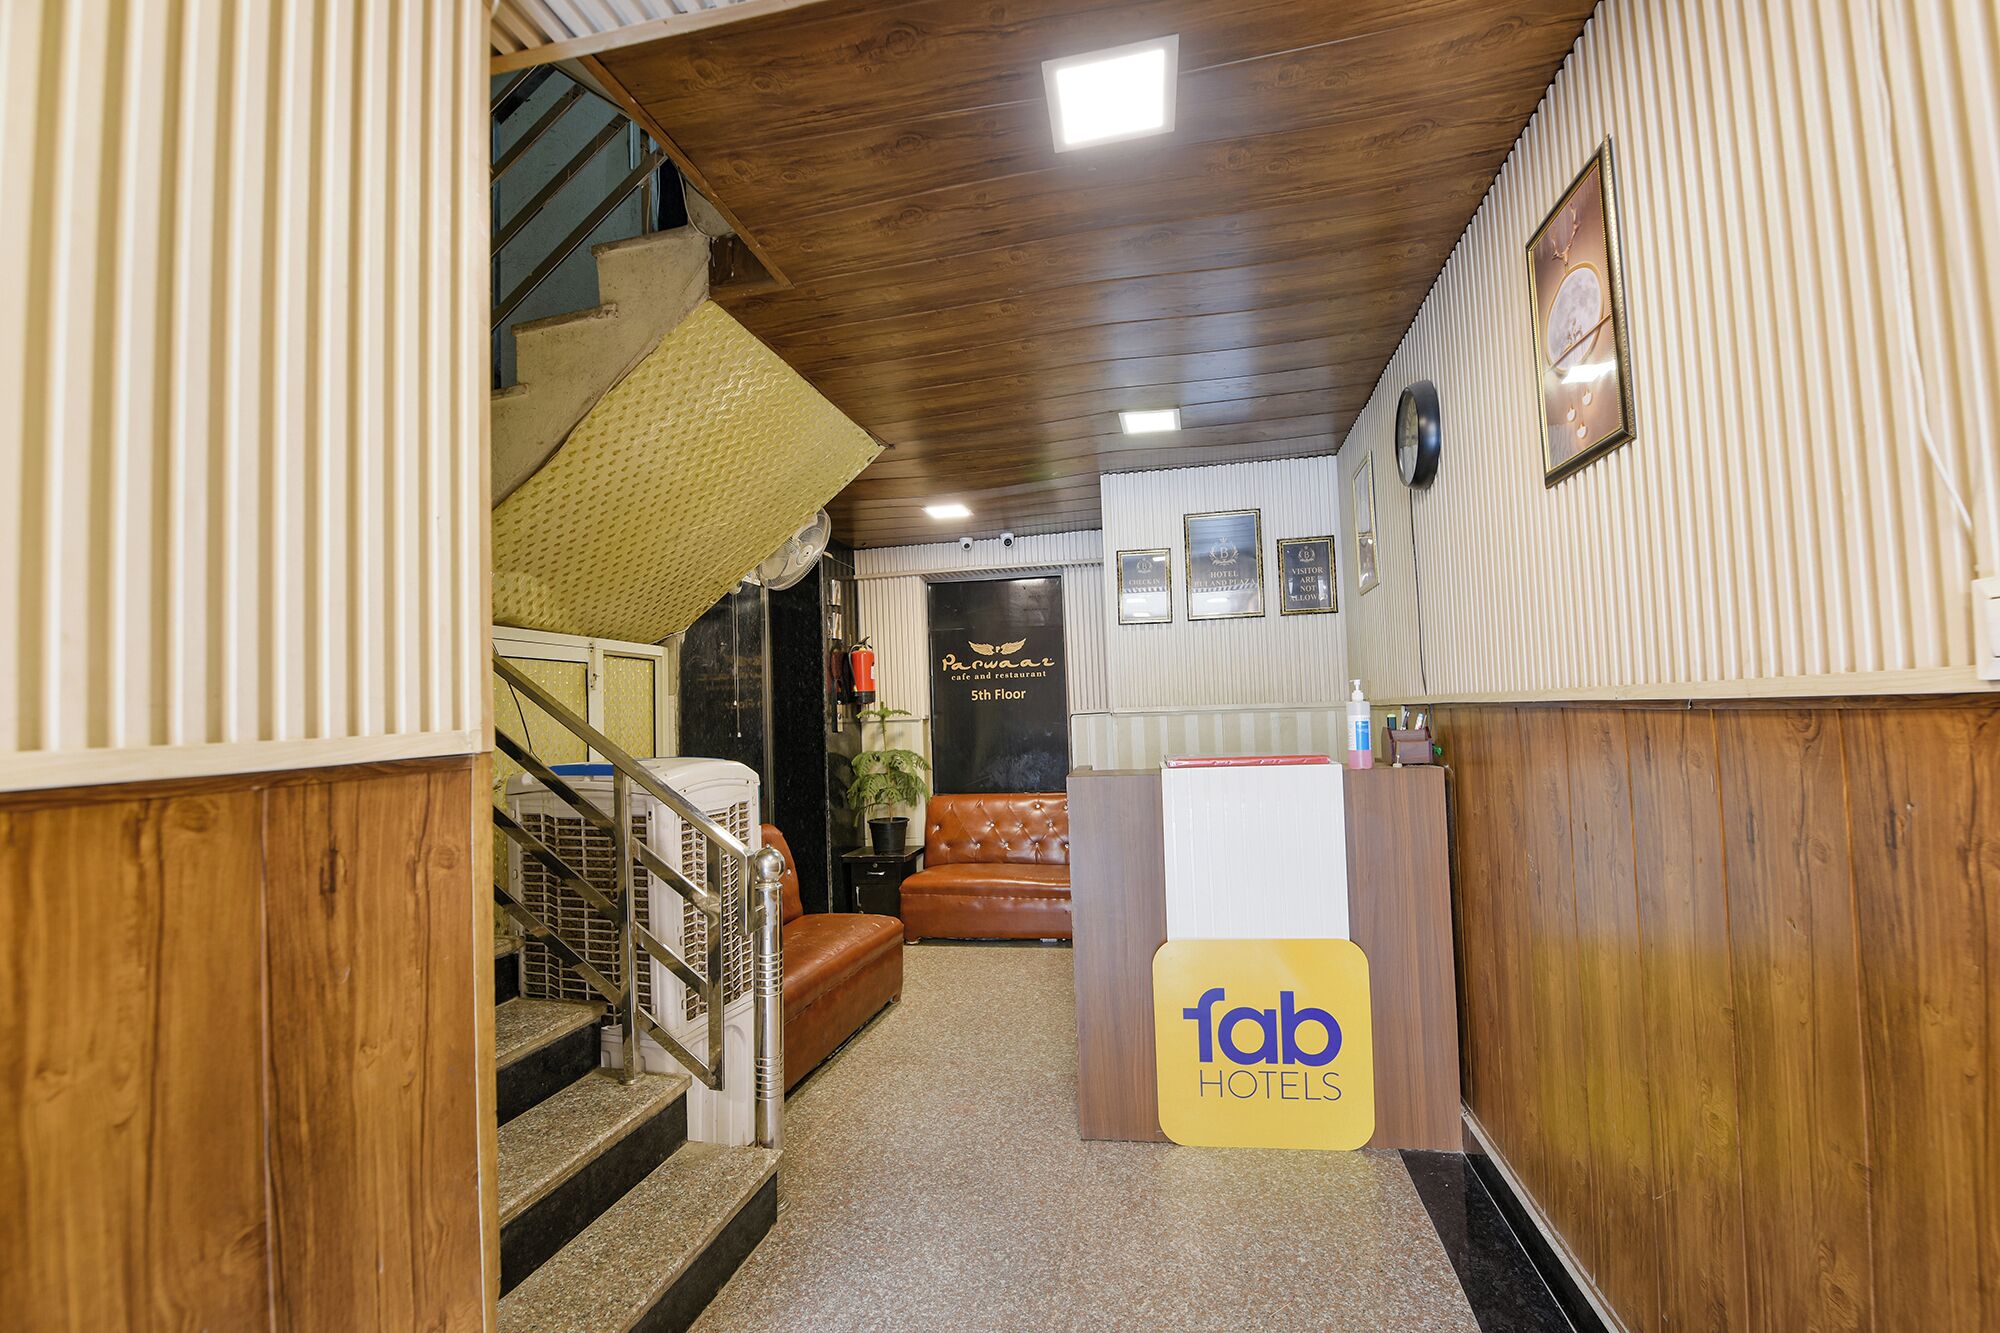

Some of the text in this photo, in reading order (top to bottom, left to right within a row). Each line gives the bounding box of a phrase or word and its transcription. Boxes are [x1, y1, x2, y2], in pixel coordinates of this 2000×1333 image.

[1219, 548, 1229, 558] B
[1210, 570, 1239, 578] HOTEL
[1292, 566, 1324, 575] VISITOR
[1229, 577, 1257, 586] PLAZA
[951, 670, 1047, 681] cafe and restaurant
[971, 688, 1027, 701] 5th Floor
[1183, 987, 1343, 1067] fab
[1199, 1069, 1342, 1101] HOTELS
